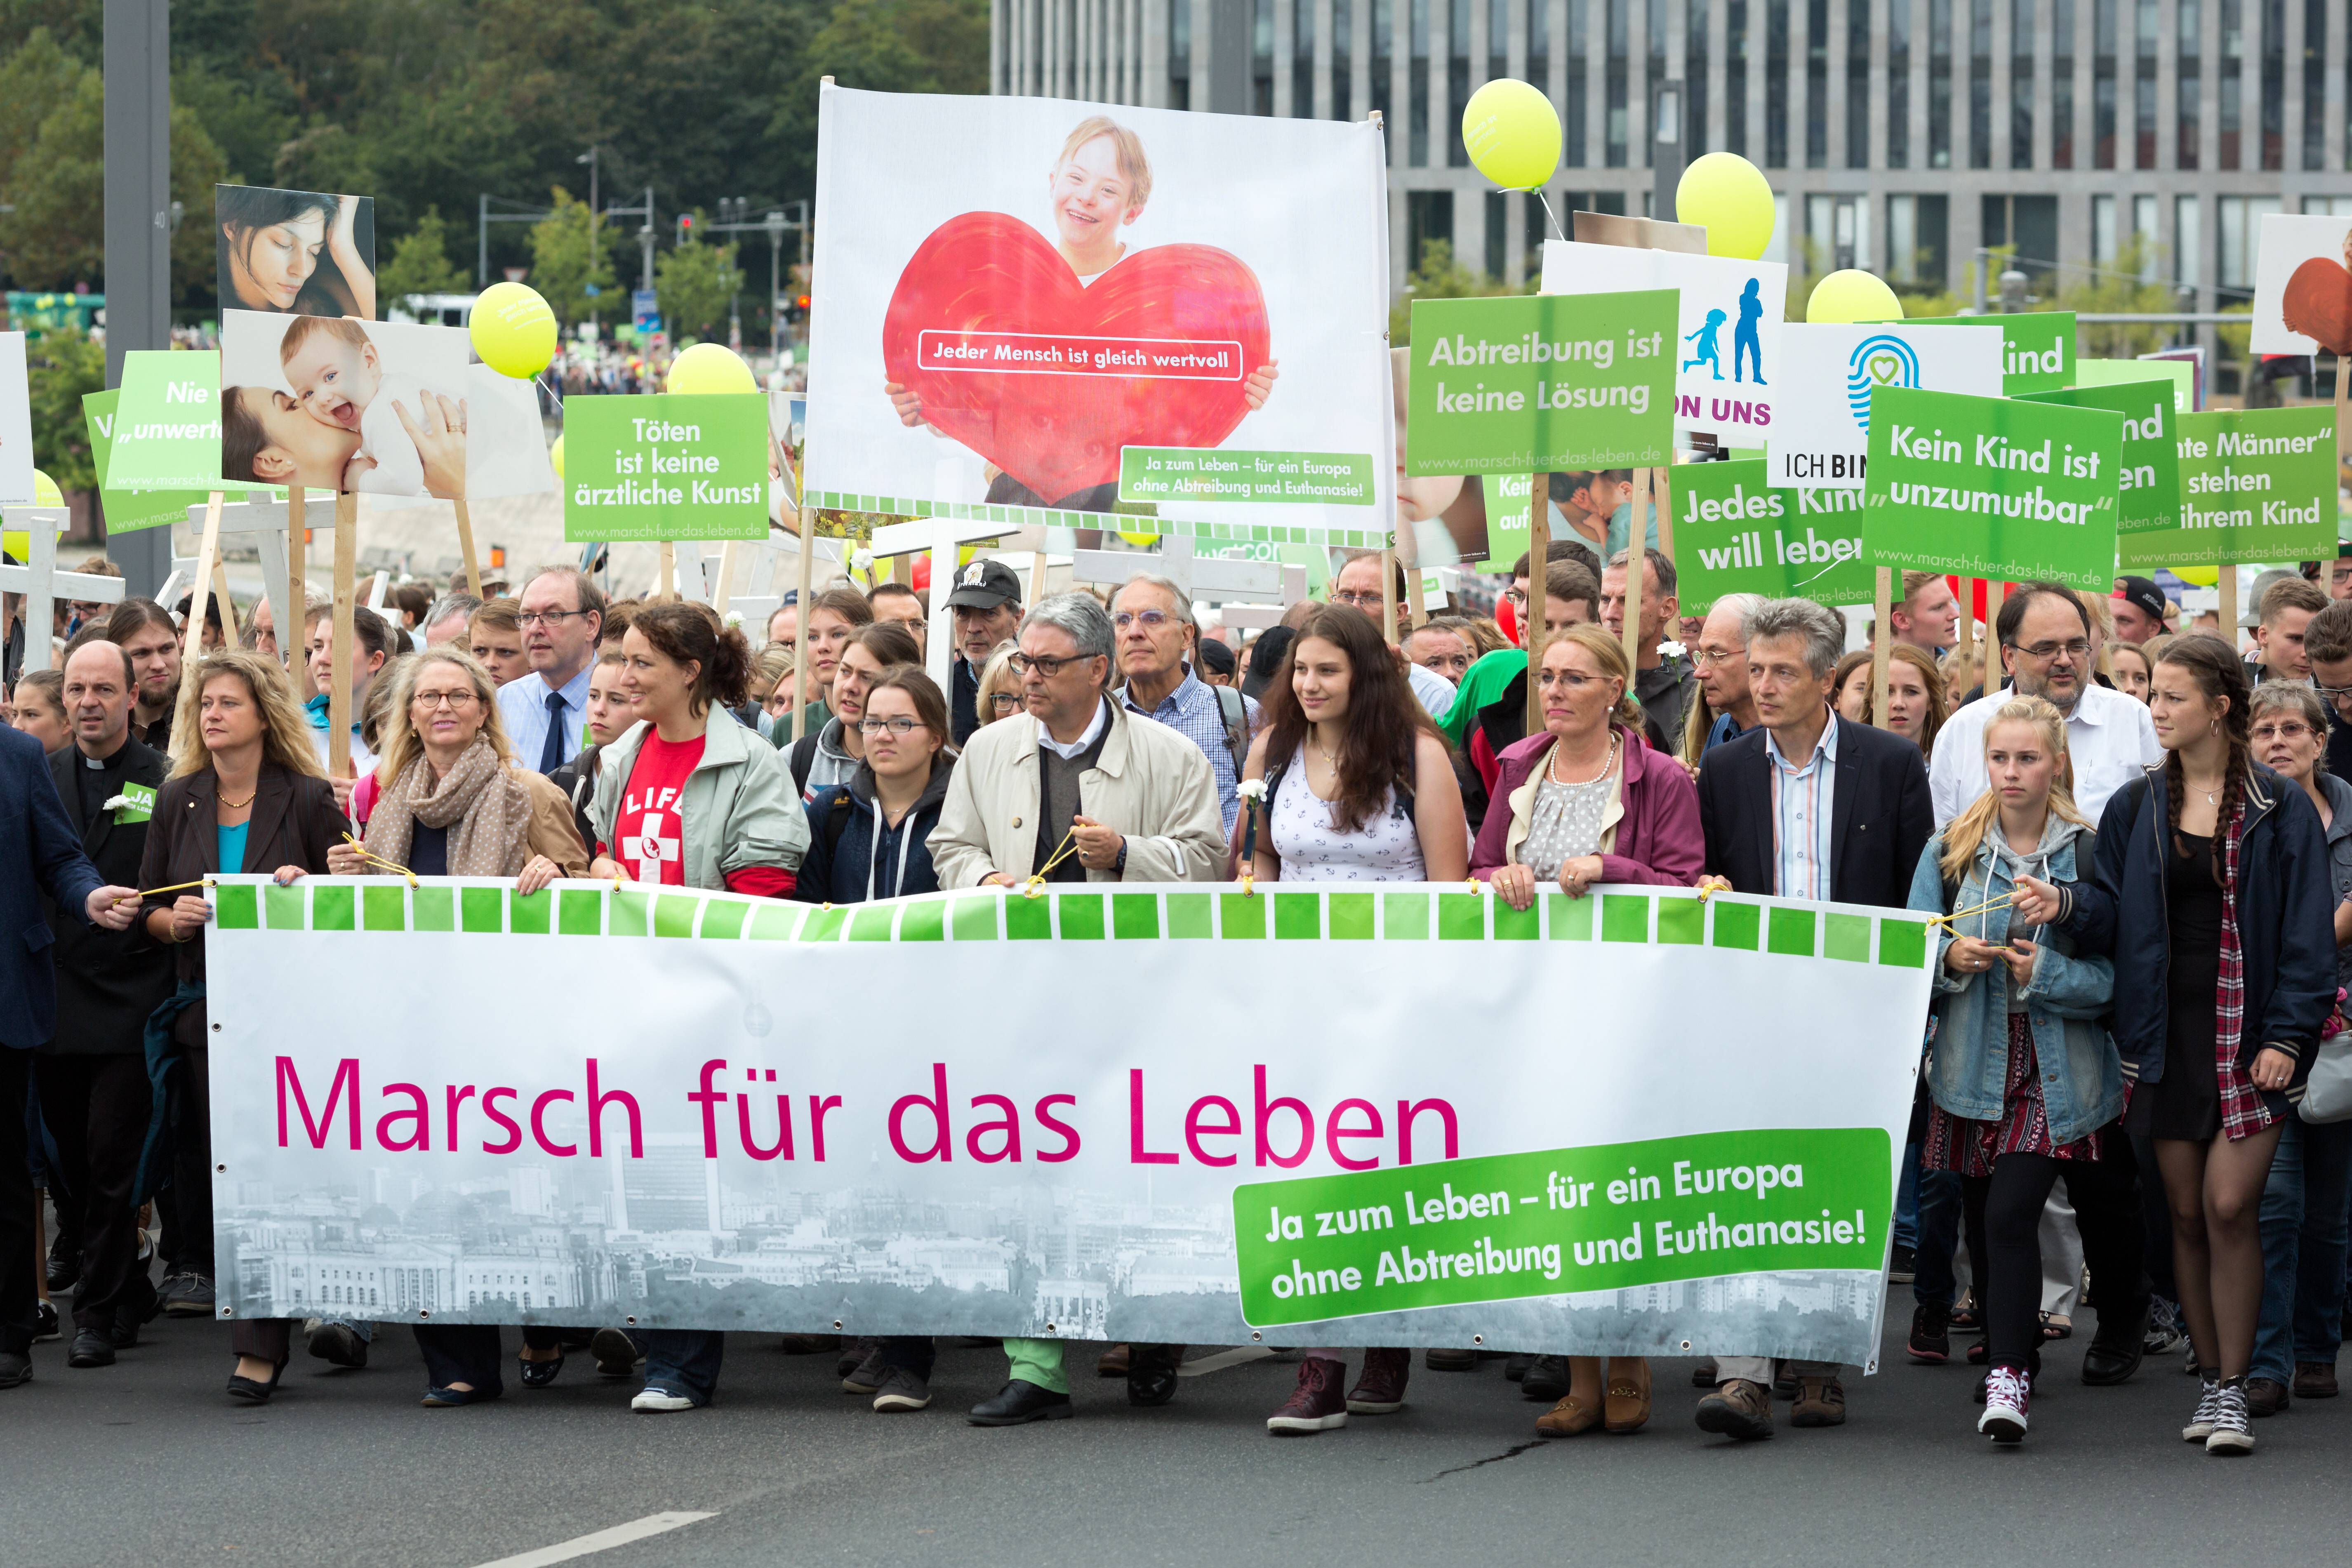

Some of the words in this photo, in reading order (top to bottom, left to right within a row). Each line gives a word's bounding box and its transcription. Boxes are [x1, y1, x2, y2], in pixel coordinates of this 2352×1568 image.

[154, 211, 165, 229] 40
[933, 342, 988, 360] Jeder
[994, 344, 1063, 363] Mensch
[1069, 348, 1088, 363] ist
[1095, 348, 1147, 368] gleich
[1153, 351, 1229, 368] wertvoll
[1428, 331, 1614, 369] Abtreibung
[1627, 329, 1662, 358] ist
[2003, 336, 2063, 375] ind
[166, 381, 208, 403] Nie
[1436, 382, 1525, 413] keine
[1537, 381, 1650, 414] Lösung
[1674, 395, 1701, 418] N
[1712, 398, 1770, 426] UNS
[2123, 403, 2163, 442] nd
[632, 418, 700, 442] Töten
[616, 449, 643, 473] ist
[652, 447, 719, 473] keine
[1417, 445, 1661, 470] www.marsch-fuer-das-leben.de
[1891, 424, 1962, 464] Kein
[1975, 434, 2051, 474] Kind
[2063, 444, 2100, 479] ist
[1145, 456, 1161, 471] Ja
[1165, 459, 1194, 471] zum
[1198, 457, 1238, 472] Leben
[1255, 457, 1274, 473] für
[1278, 460, 1298, 474] ein
[1303, 461, 1351, 478] Europa
[1786, 453, 1824, 478] ICH
[2119, 464, 2156, 491] en
[575, 478, 683, 506] ärztliche
[692, 480, 761, 504] Kunst
[1133, 477, 1169, 492] ohne
[1172, 478, 1250, 497] Abtreibung
[1255, 480, 1281, 494] und
[1285, 480, 1363, 497] Euthanasie!
[2188, 466, 2271, 494] stehen
[1683, 483, 1785, 523] Jedes
[2180, 503, 2252, 529] ihrem
[2262, 497, 2320, 526] Kind
[574, 523, 761, 537] www.marsch-fuer-das-leben.de
[2117, 512, 2171, 530] eben.de
[1697, 531, 1763, 570] will
[2130, 542, 2329, 564] www.marsch-fuer-das-leben.de
[1873, 548, 2102, 586] www.marsch-fuer-das-leben.de
[130, 790, 152, 807] JA
[137, 805, 152, 814] LEBE
[275, 1055, 643, 1158] Marsch
[687, 1059, 842, 1162] für
[888, 1063, 1081, 1164] das
[1130, 1064, 1459, 1170] Leben
[1264, 1207, 1303, 1243] Ja
[1316, 1206, 1394, 1238] zum
[1404, 1183, 1510, 1227] Leben
[1547, 1171, 1594, 1211] für
[1607, 1167, 1661, 1205] ein
[1674, 1159, 1803, 1200] Europa
[1271, 1258, 1362, 1299] ohne
[1375, 1236, 1561, 1281] Abtreibung
[1573, 1222, 1643, 1267] und
[1654, 1208, 1866, 1257] Euthanasie!
